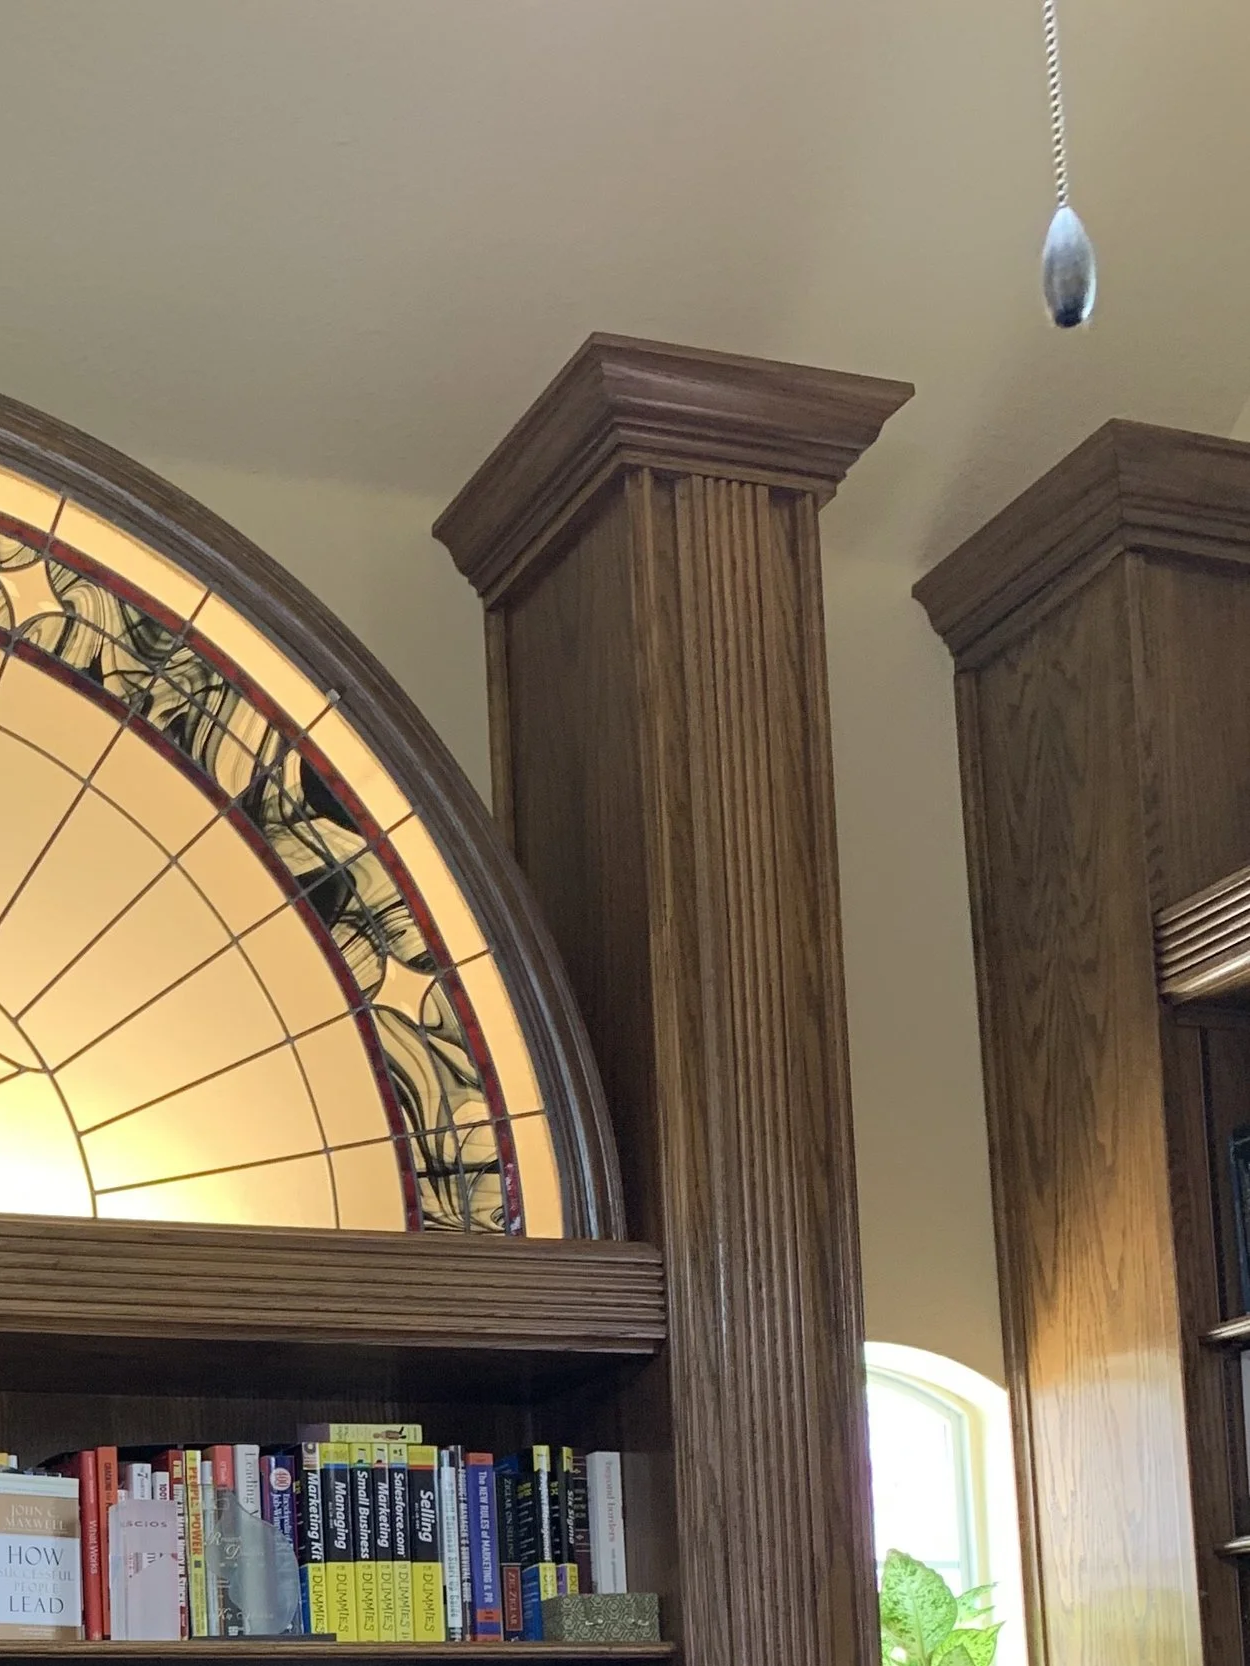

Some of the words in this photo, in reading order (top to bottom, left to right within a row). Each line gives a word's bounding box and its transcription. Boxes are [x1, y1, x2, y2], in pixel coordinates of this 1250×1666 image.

[159, 1483, 167, 1500] 1001
[244, 1452, 257, 1505] Leading
[276, 1470, 289, 1487] 400
[356, 1470, 369, 1505] Small
[478, 1471, 487, 1485] The
[478, 1487, 488, 1504] NEW
[604, 1461, 615, 1499] beyond
[5, 1516, 65, 1531] MAXWELL
[305, 1472, 320, 1540] Marketing
[333, 1481, 348, 1550] Managing
[376, 1482, 391, 1548] Marketing
[393, 1472, 406, 1555] Salesforce.com
[419, 1490, 435, 1543] Selling
[479, 1506, 489, 1529] RULES
[607, 1503, 616, 1543] borders
[88, 1520, 97, 1544] What
[190, 1513, 202, 1556] POWER
[310, 1542, 322, 1560] Kit
[357, 1506, 371, 1559] Business
[8, 1545, 64, 1566] HOW
[89, 1546, 98, 1575] Works
[481, 1540, 492, 1583] MARKETING
[14, 1582, 59, 1594] PEOPLE
[484, 1593, 493, 1603] PR
[508, 1572, 517, 1588] ZIG
[9, 1595, 64, 1614] LEAD
[312, 1575, 324, 1633] DUMMIES
[336, 1573, 350, 1633] DUMMIES
[362, 1573, 375, 1632] DUMMIES
[380, 1573, 394, 1632] DUMMIES
[397, 1571, 411, 1629] DUMMIES
[421, 1573, 436, 1633] DUMMIES
[509, 1591, 518, 1625] ZIGLAR
